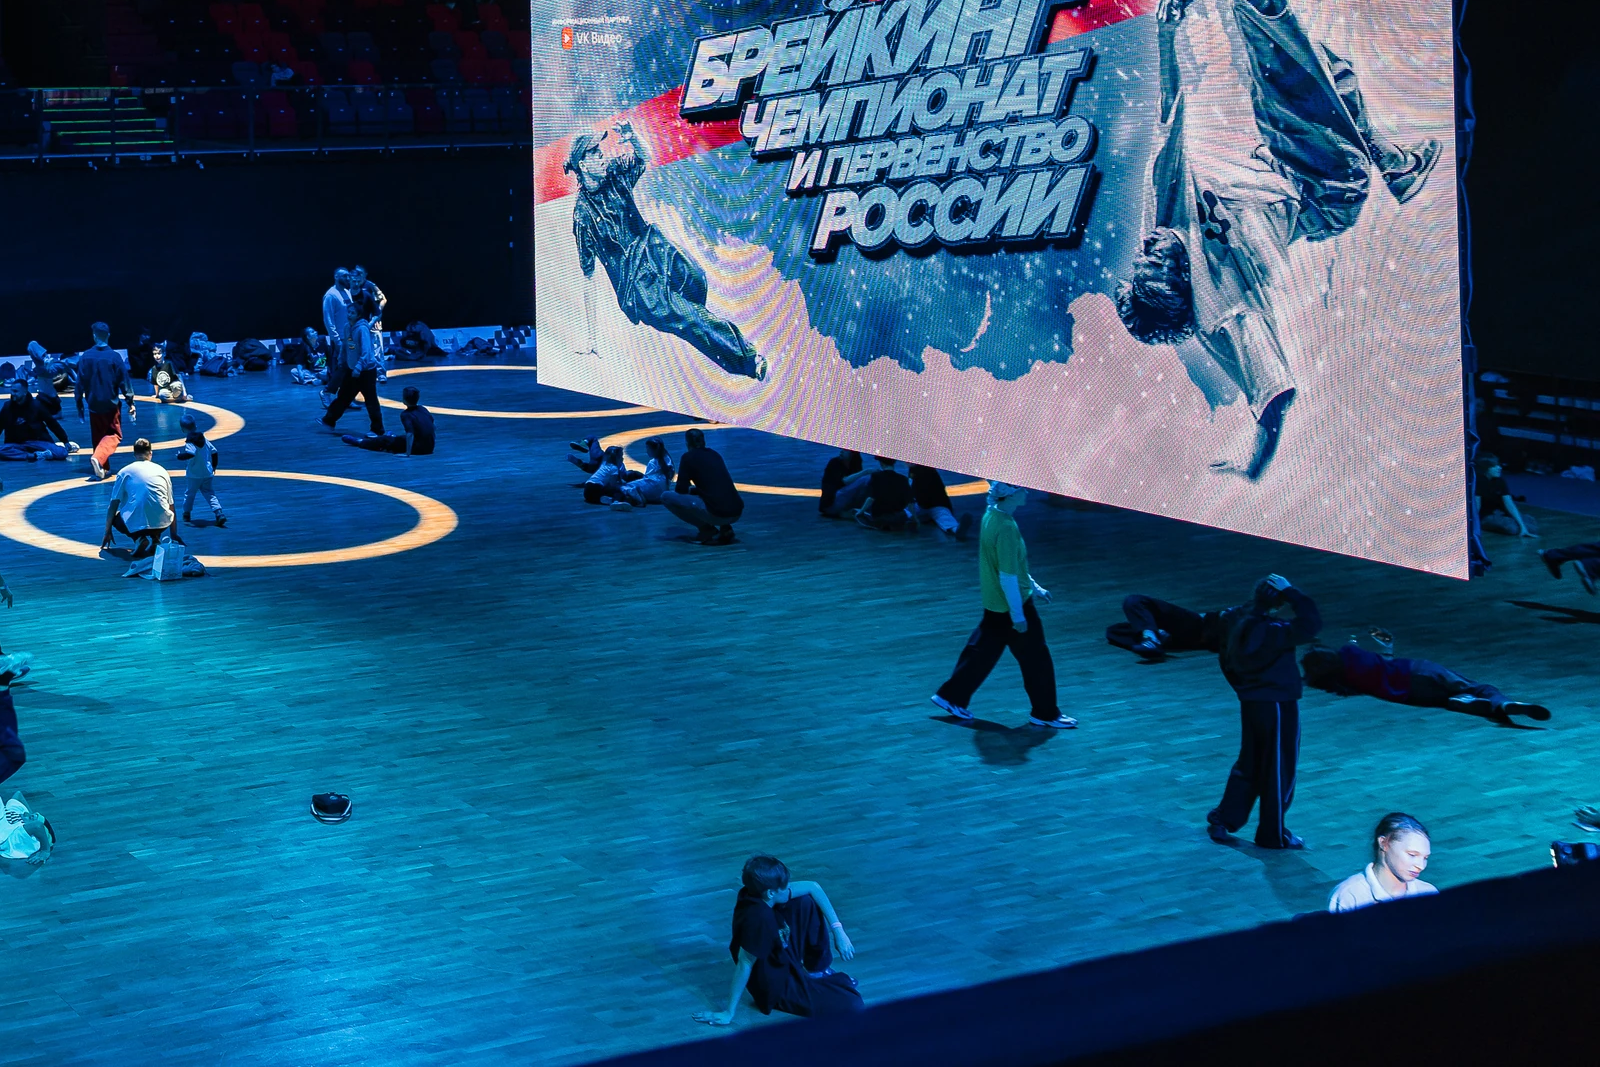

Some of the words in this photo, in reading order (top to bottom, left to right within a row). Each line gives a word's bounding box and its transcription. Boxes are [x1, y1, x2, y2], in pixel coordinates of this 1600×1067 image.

[576, 32, 591, 44] VK
[591, 31, 623, 46] Видео
[739, 49, 1090, 155] ЧЕМПИОНАТ
[788, 149, 821, 193] И
[819, 115, 1093, 188] ПЕРВЕНСТВО
[814, 164, 1092, 252] РОССИИ
